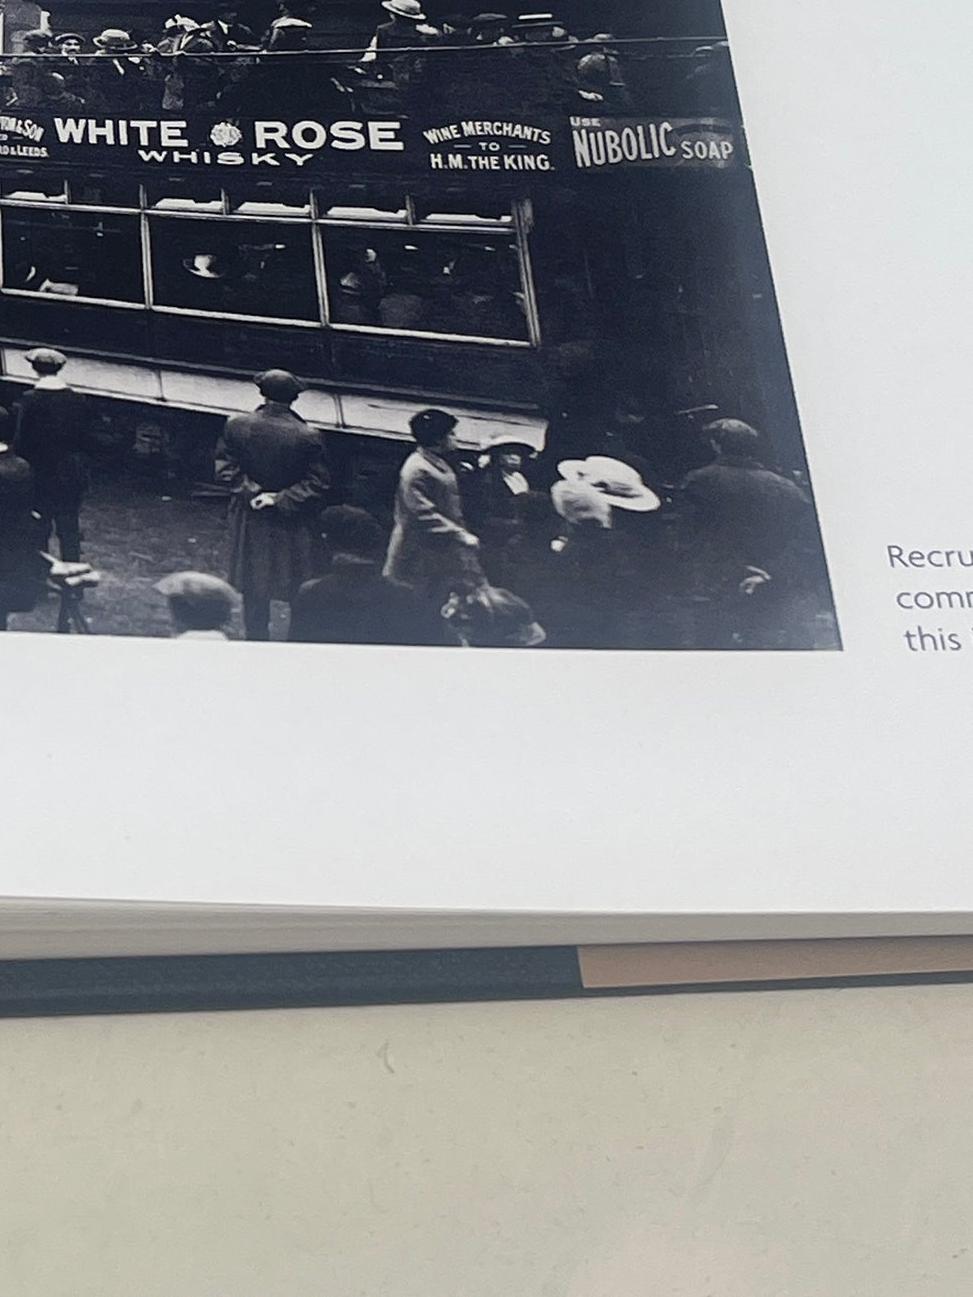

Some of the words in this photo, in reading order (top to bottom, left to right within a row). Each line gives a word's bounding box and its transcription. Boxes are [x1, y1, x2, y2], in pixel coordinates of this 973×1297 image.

[569, 116, 602, 128] USE
[53, 117, 189, 148] WHITE
[254, 120, 405, 151] ROSE
[422, 124, 461, 144] WINE
[461, 121, 552, 145] MERCHANTS
[478, 142, 501, 151] TO
[572, 121, 677, 168] NUBOLIC
[680, 140, 735, 160] SOAP
[137, 150, 315, 166] WHISKY
[467, 155, 501, 170] THE
[904, 625, 962, 652] this
